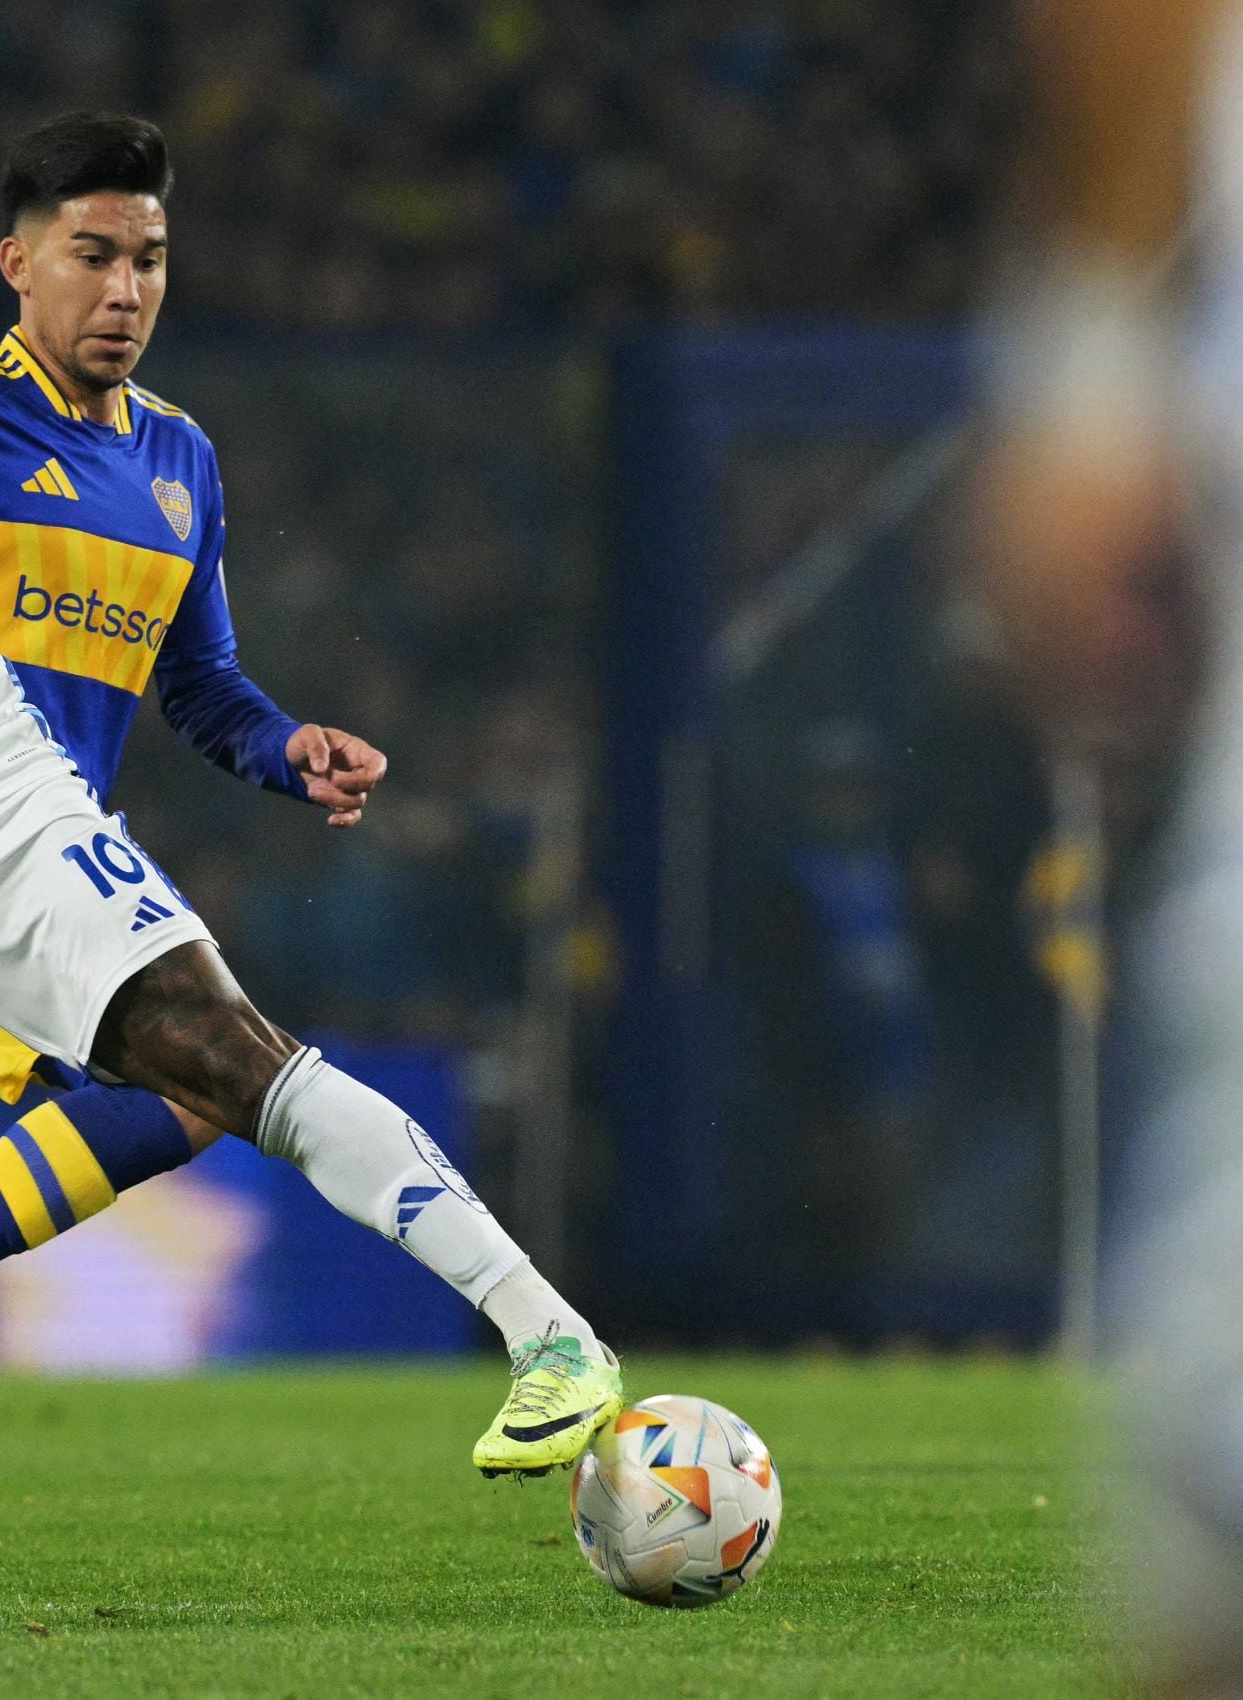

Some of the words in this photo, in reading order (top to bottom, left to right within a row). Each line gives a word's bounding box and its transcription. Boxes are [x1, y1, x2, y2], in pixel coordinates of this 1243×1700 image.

[13, 574, 169, 651] betsso
[61, 832, 146, 899] 10
[647, 1497, 673, 1525] Cumbre
